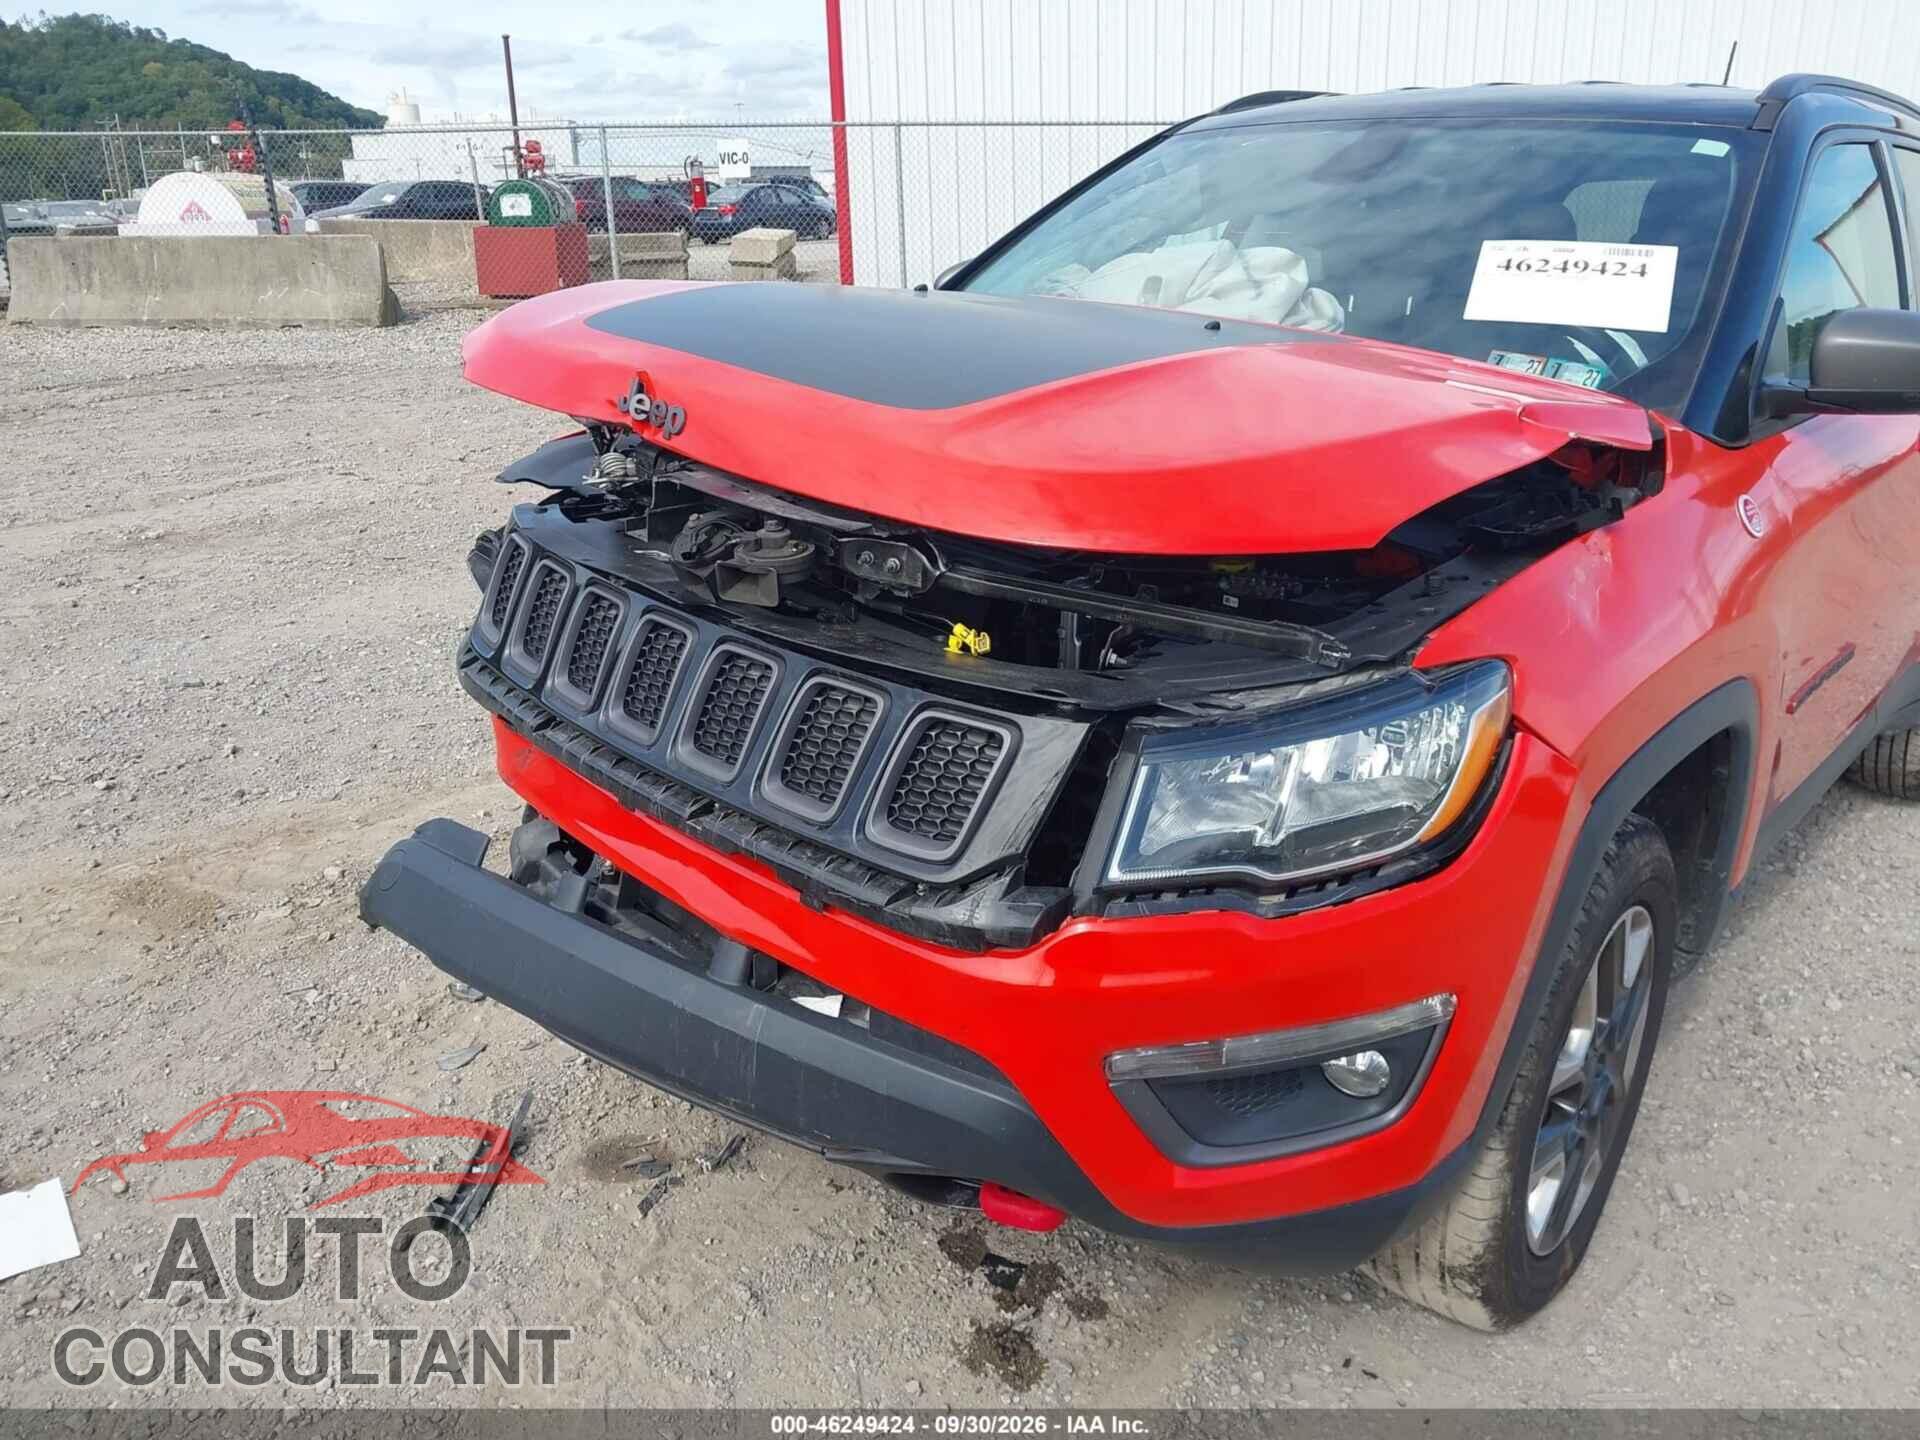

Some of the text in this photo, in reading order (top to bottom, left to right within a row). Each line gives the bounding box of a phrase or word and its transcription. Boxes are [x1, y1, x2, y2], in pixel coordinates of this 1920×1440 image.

[1497, 257, 1648, 278] 46249424
[1583, 369, 1601, 387] 27
[617, 376, 687, 440] Jeep
